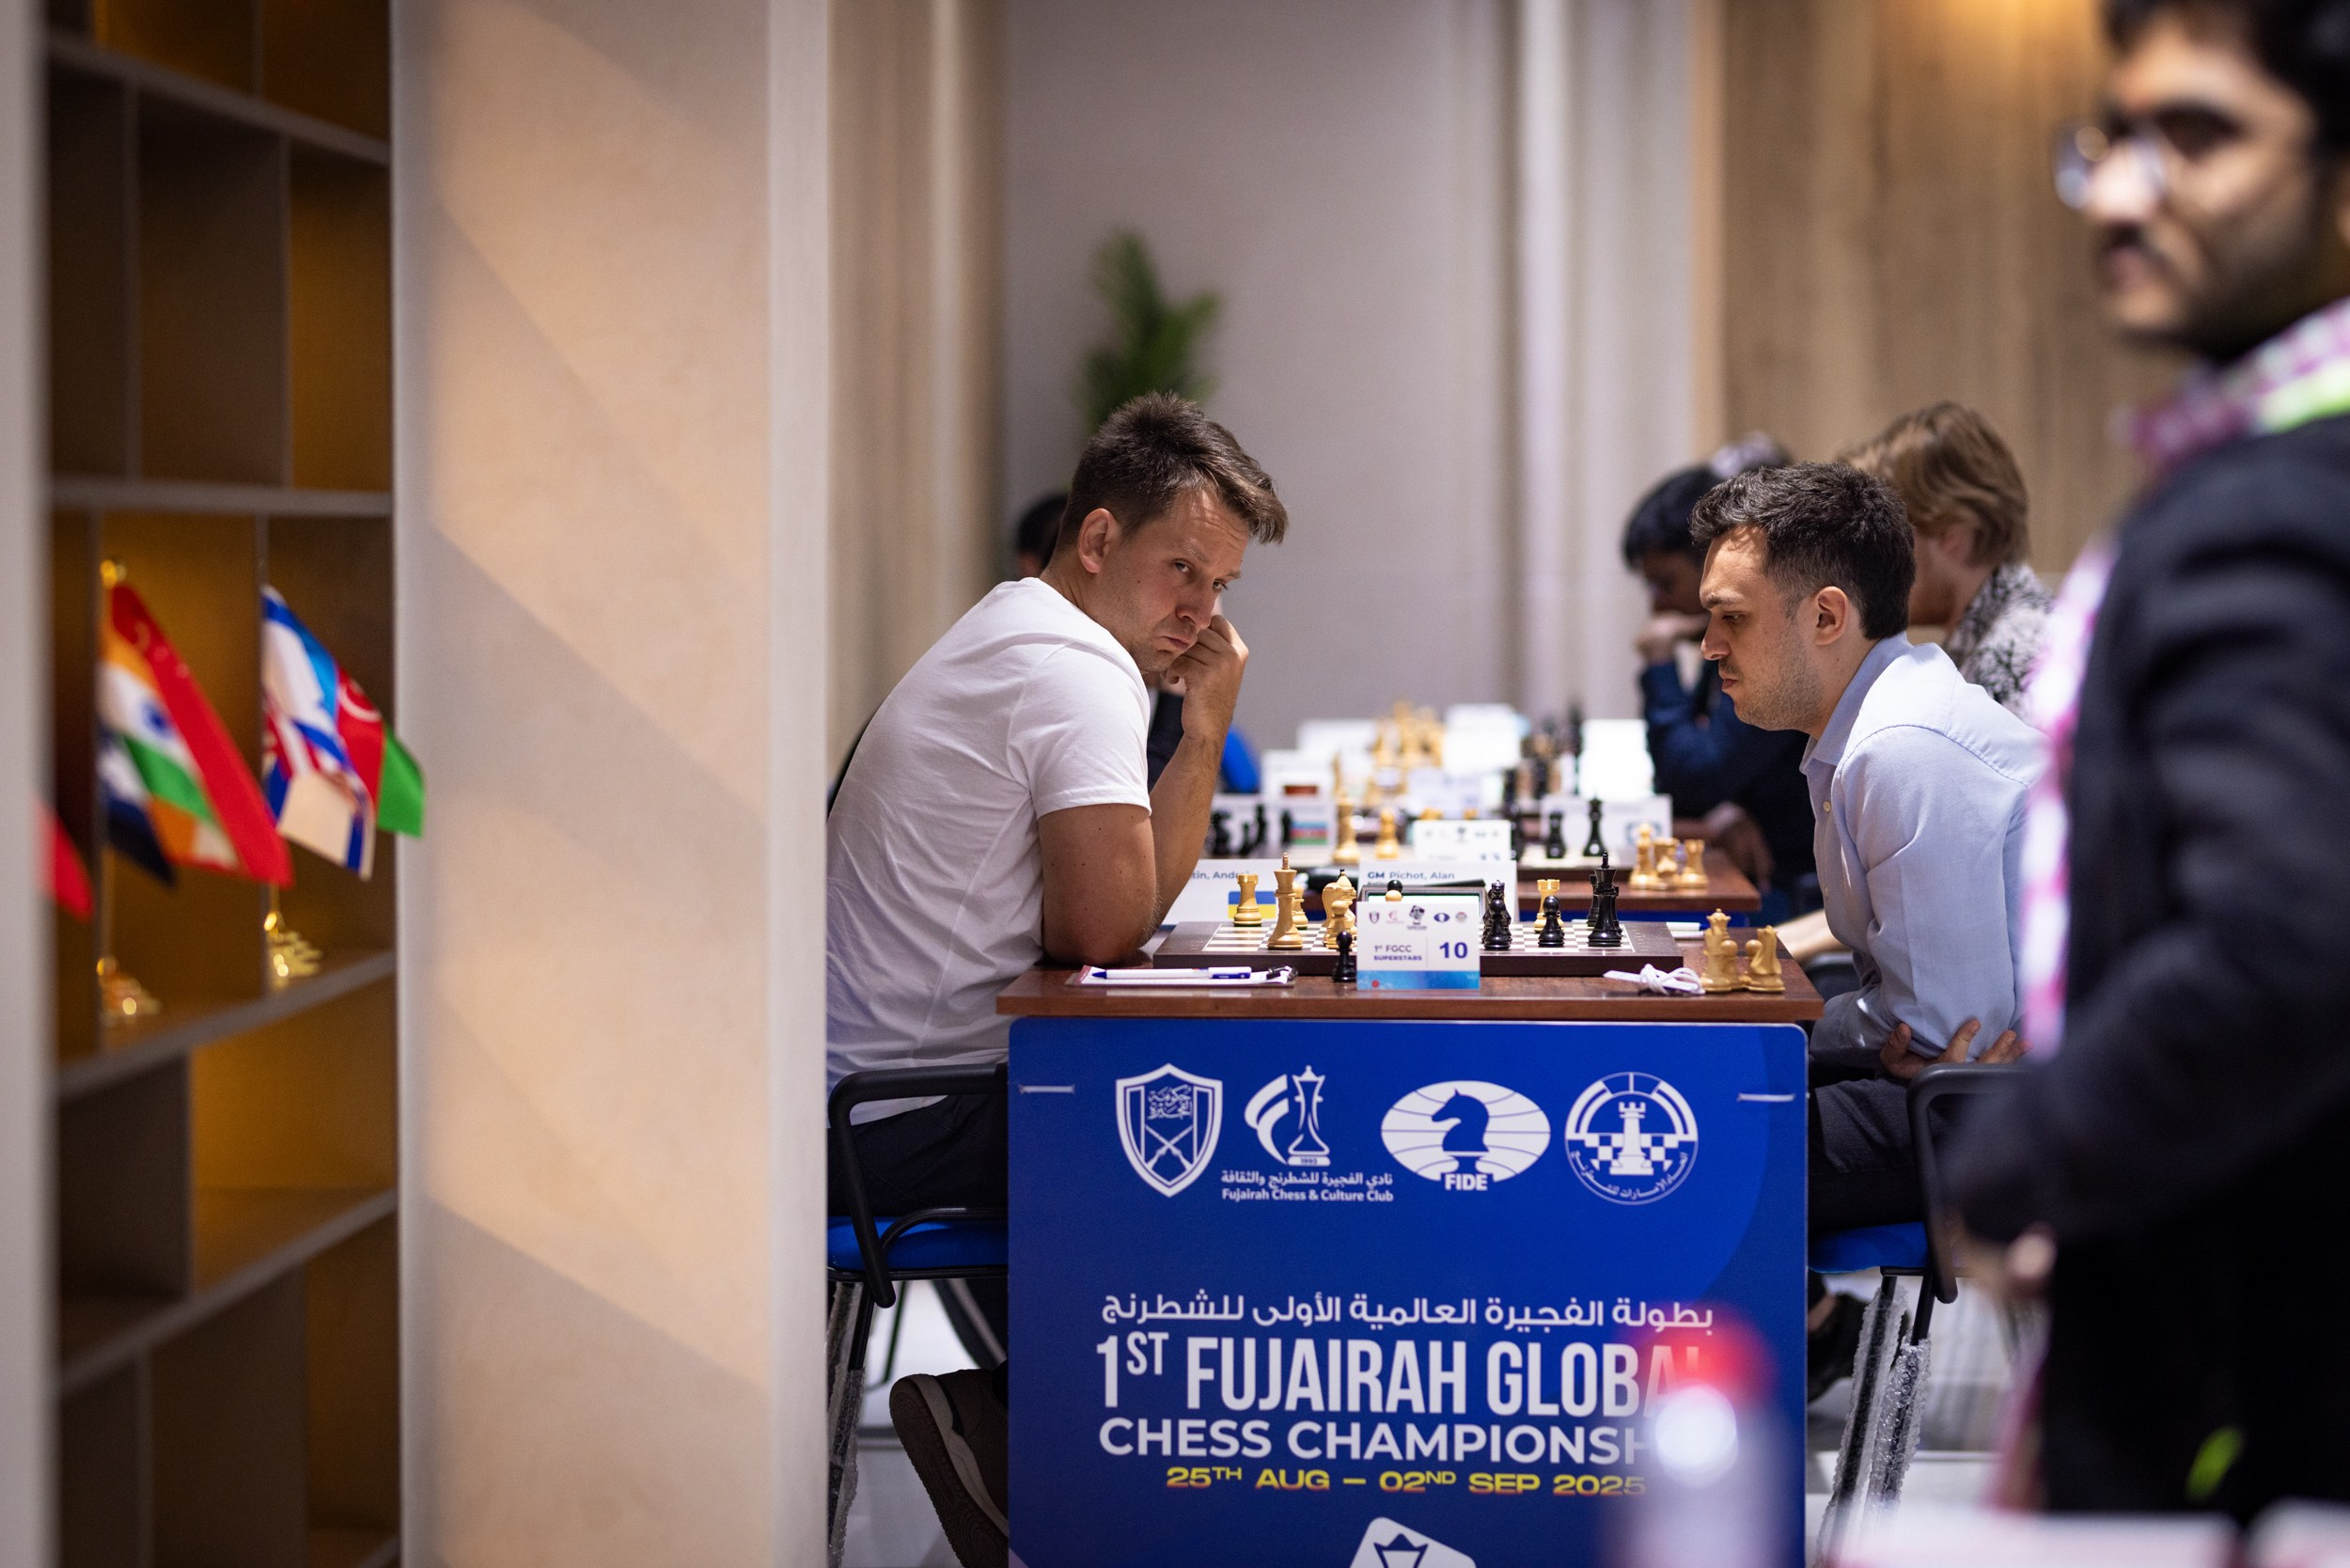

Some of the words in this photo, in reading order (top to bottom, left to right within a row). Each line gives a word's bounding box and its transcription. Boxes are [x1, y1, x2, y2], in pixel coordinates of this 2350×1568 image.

[1213, 870, 1249, 880] Andr
[1389, 870, 1427, 880] Pichot,
[1430, 870, 1455, 879] Alan
[1439, 942, 1468, 959] 10
[1221, 1170, 1265, 1186] والثقافة
[1268, 1171, 1319, 1189] للشطرنج
[1322, 1171, 1363, 1188] الفجيرة
[1366, 1172, 1393, 1190] نادي
[1445, 1173, 1488, 1191] FIDE
[1222, 1188, 1269, 1202] Fujairah
[1272, 1188, 1307, 1200] Chess
[1308, 1189, 1319, 1200] &
[1321, 1189, 1365, 1201] Culture
[1366, 1190, 1394, 1201] Club
[1102, 1289, 1244, 1325] للشطرنج
[1252, 1291, 1340, 1326] الأولى
[1349, 1294, 1476, 1330] العالمية
[1484, 1297, 1604, 1333] الفجيرة
[1612, 1297, 1713, 1336] بطولة
[1096, 1330, 1169, 1408] 1ST
[1186, 1336, 1466, 1414] FUJAIRAH
[1099, 1417, 1272, 1458] CHESS
[1287, 1419, 1651, 1465] CHAMPIONSH
[1167, 1466, 1243, 1489] 25TH
[1255, 1468, 1330, 1491] AUG
[1379, 1470, 1456, 1493] 02ND
[1468, 1472, 1541, 1495] SEP
[1553, 1474, 1646, 1496] 2025
